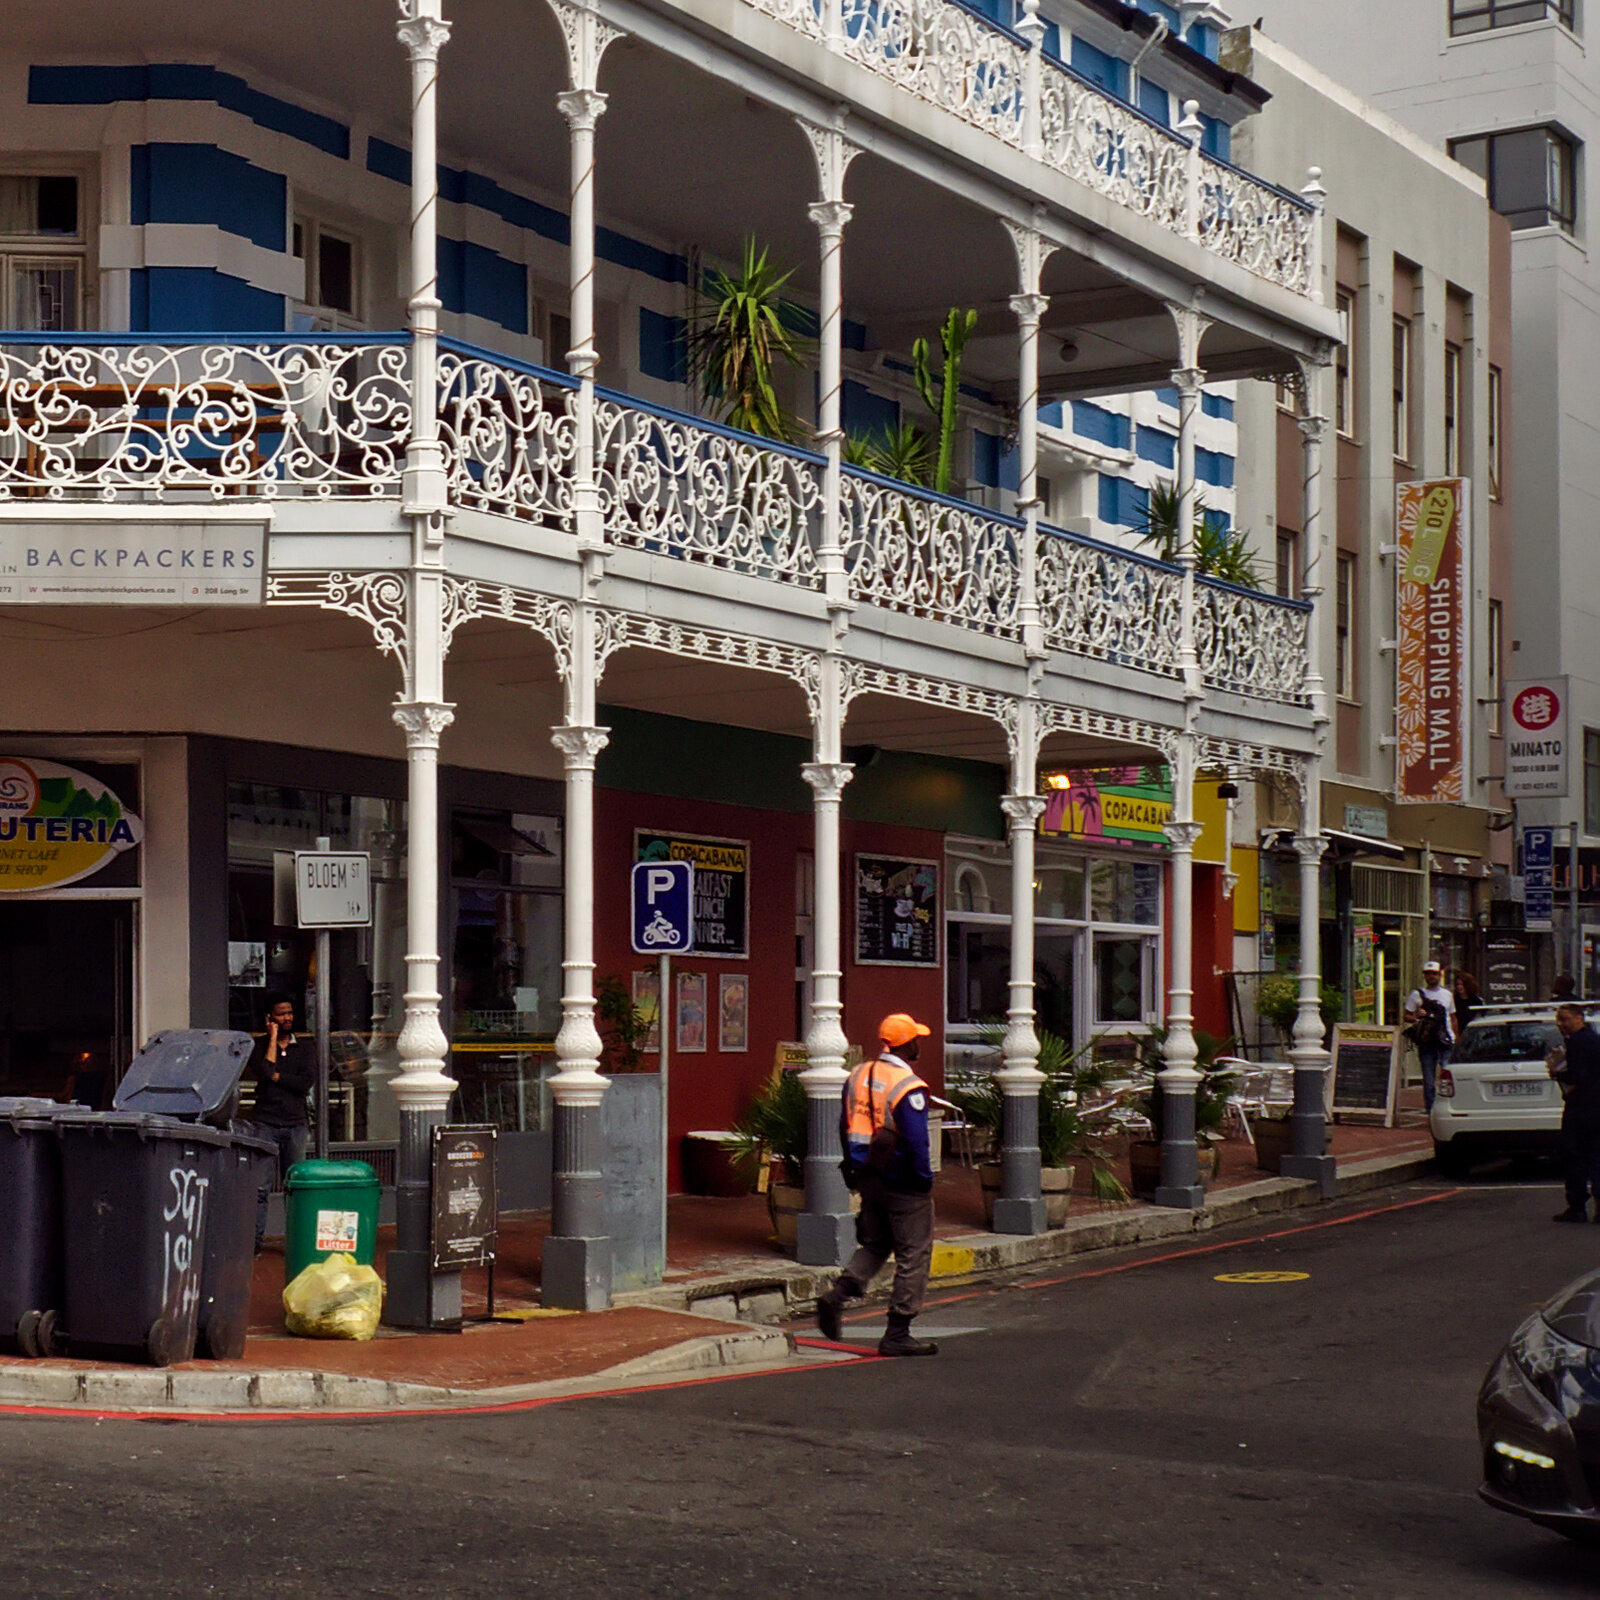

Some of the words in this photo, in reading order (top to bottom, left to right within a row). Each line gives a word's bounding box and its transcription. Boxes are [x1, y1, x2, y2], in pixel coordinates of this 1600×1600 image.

[26, 548, 255, 568] BACKPACKERS
[220, 587, 235, 597] Long
[236, 587, 249, 596] Str
[1429, 577, 1450, 700] SHOPPING
[1429, 708, 1450, 771] MALL
[1510, 740, 1562, 757] MINATO
[1105, 801, 1172, 825] COPACABAN
[1530, 833, 1546, 850] P
[671, 844, 744, 868] COPACABANA
[14, 864, 48, 875] SHOP
[307, 862, 348, 889] BLOEM
[351, 863, 360, 878] ST
[647, 869, 675, 905] P
[694, 896, 725, 919] UNCH
[323, 1240, 350, 1250] Litter
